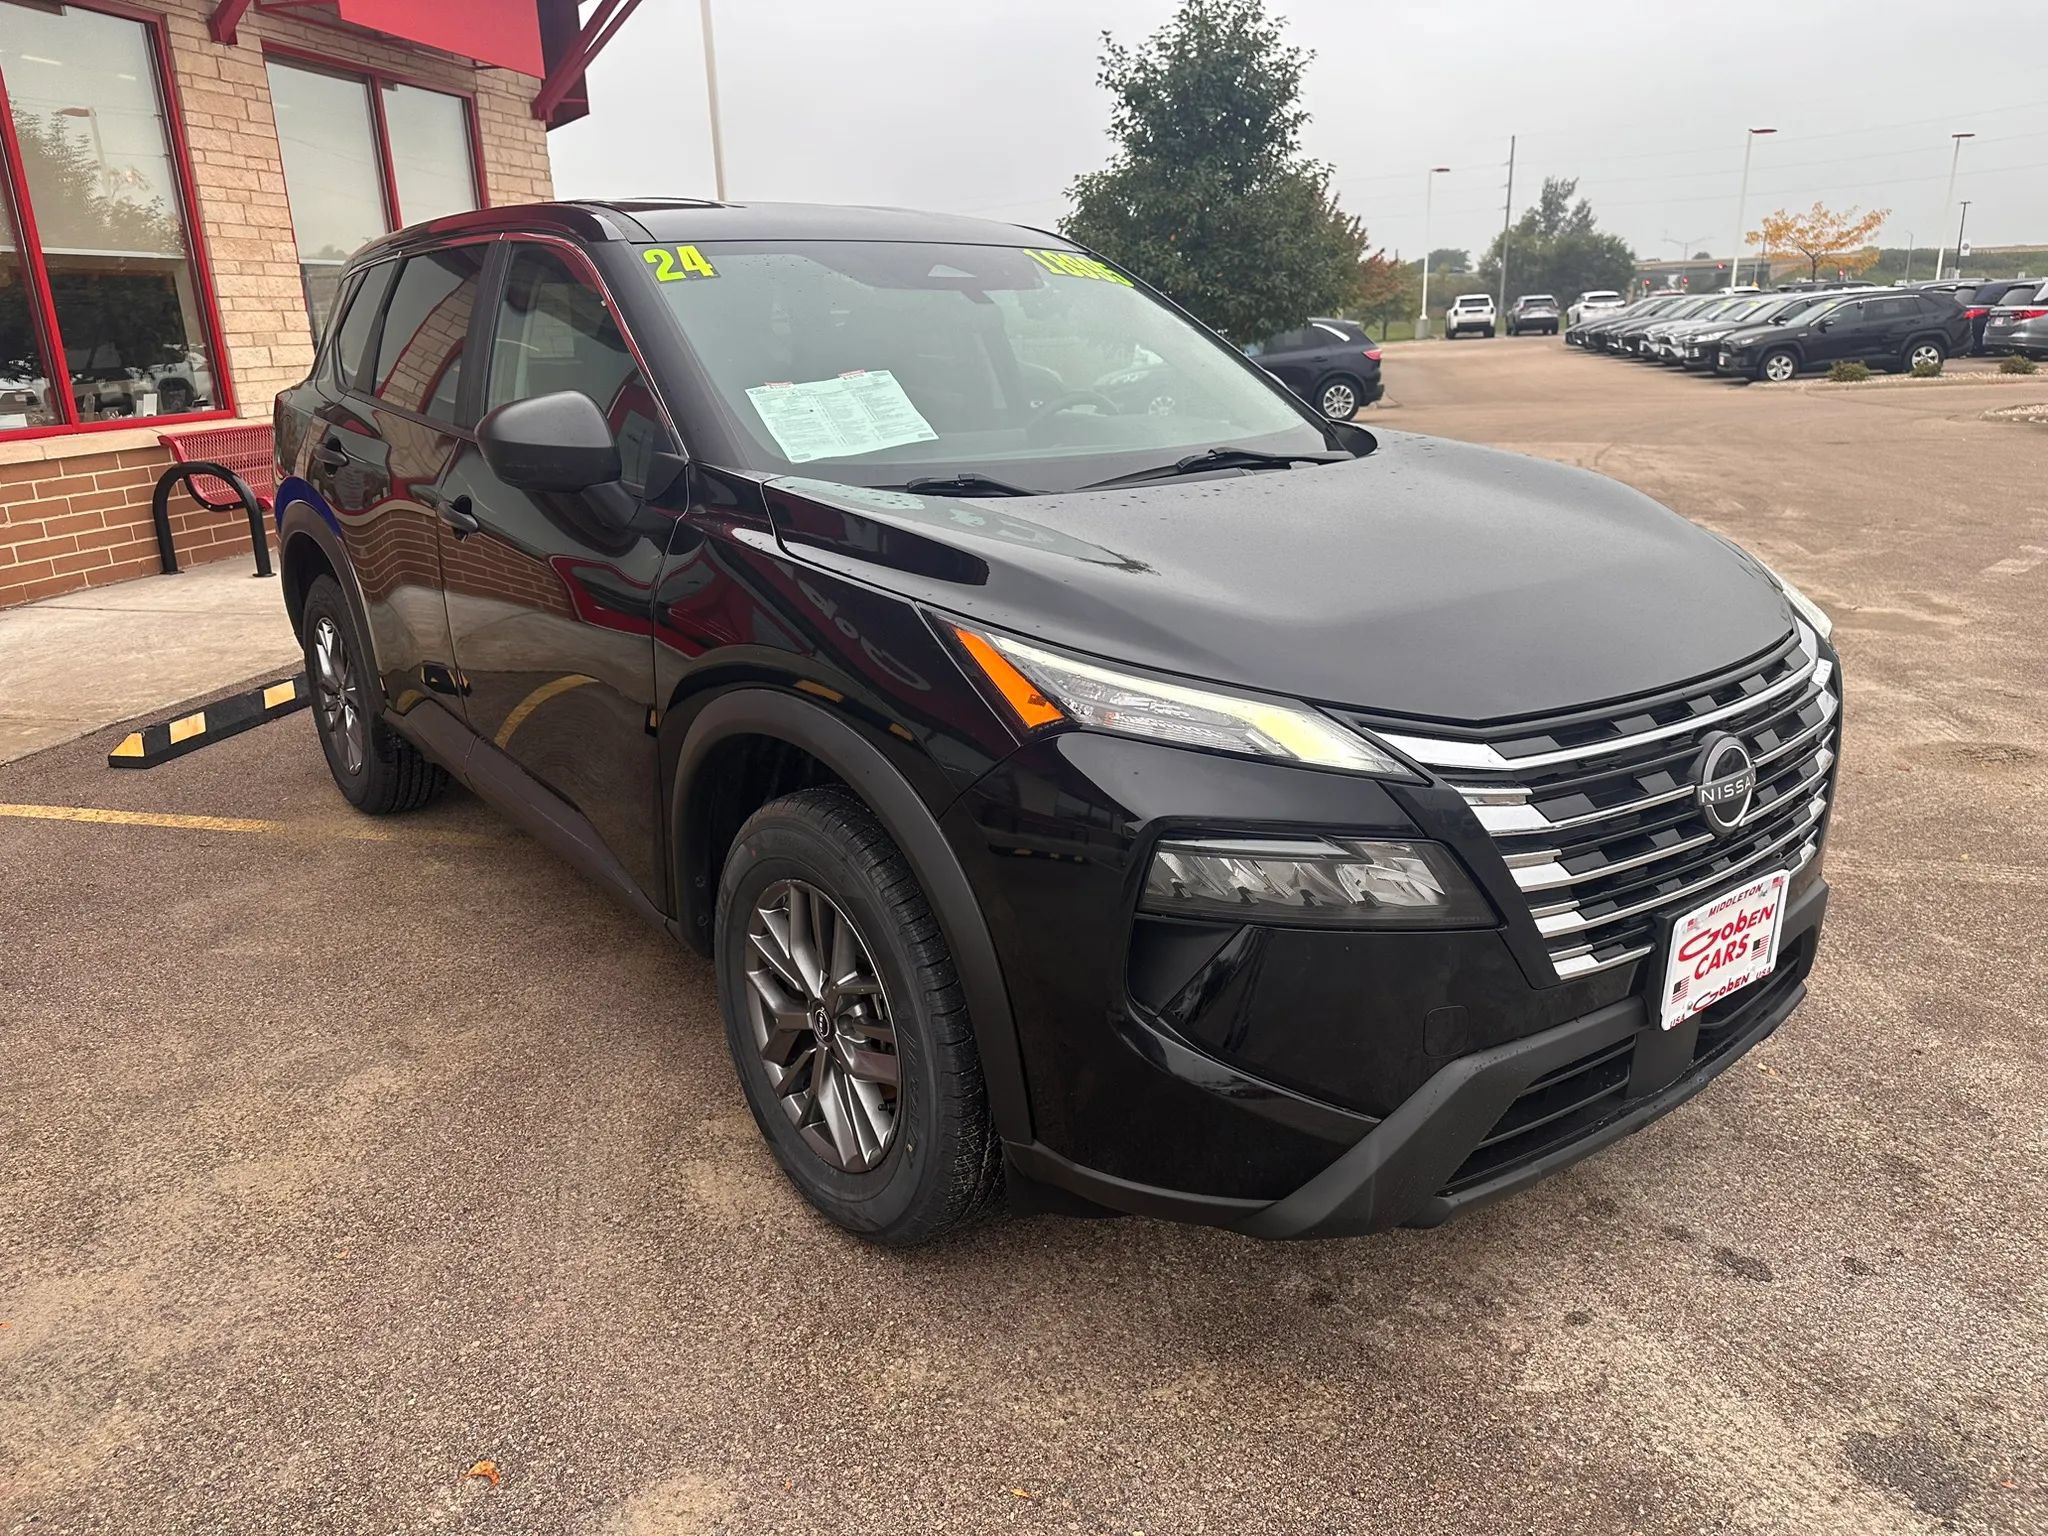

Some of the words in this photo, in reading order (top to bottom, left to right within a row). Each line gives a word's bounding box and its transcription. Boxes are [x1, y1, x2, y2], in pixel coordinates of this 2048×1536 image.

[643, 245, 714, 281] 24
[1708, 883, 1763, 917] MIDDLETON
[1694, 934, 1750, 980] CARS
